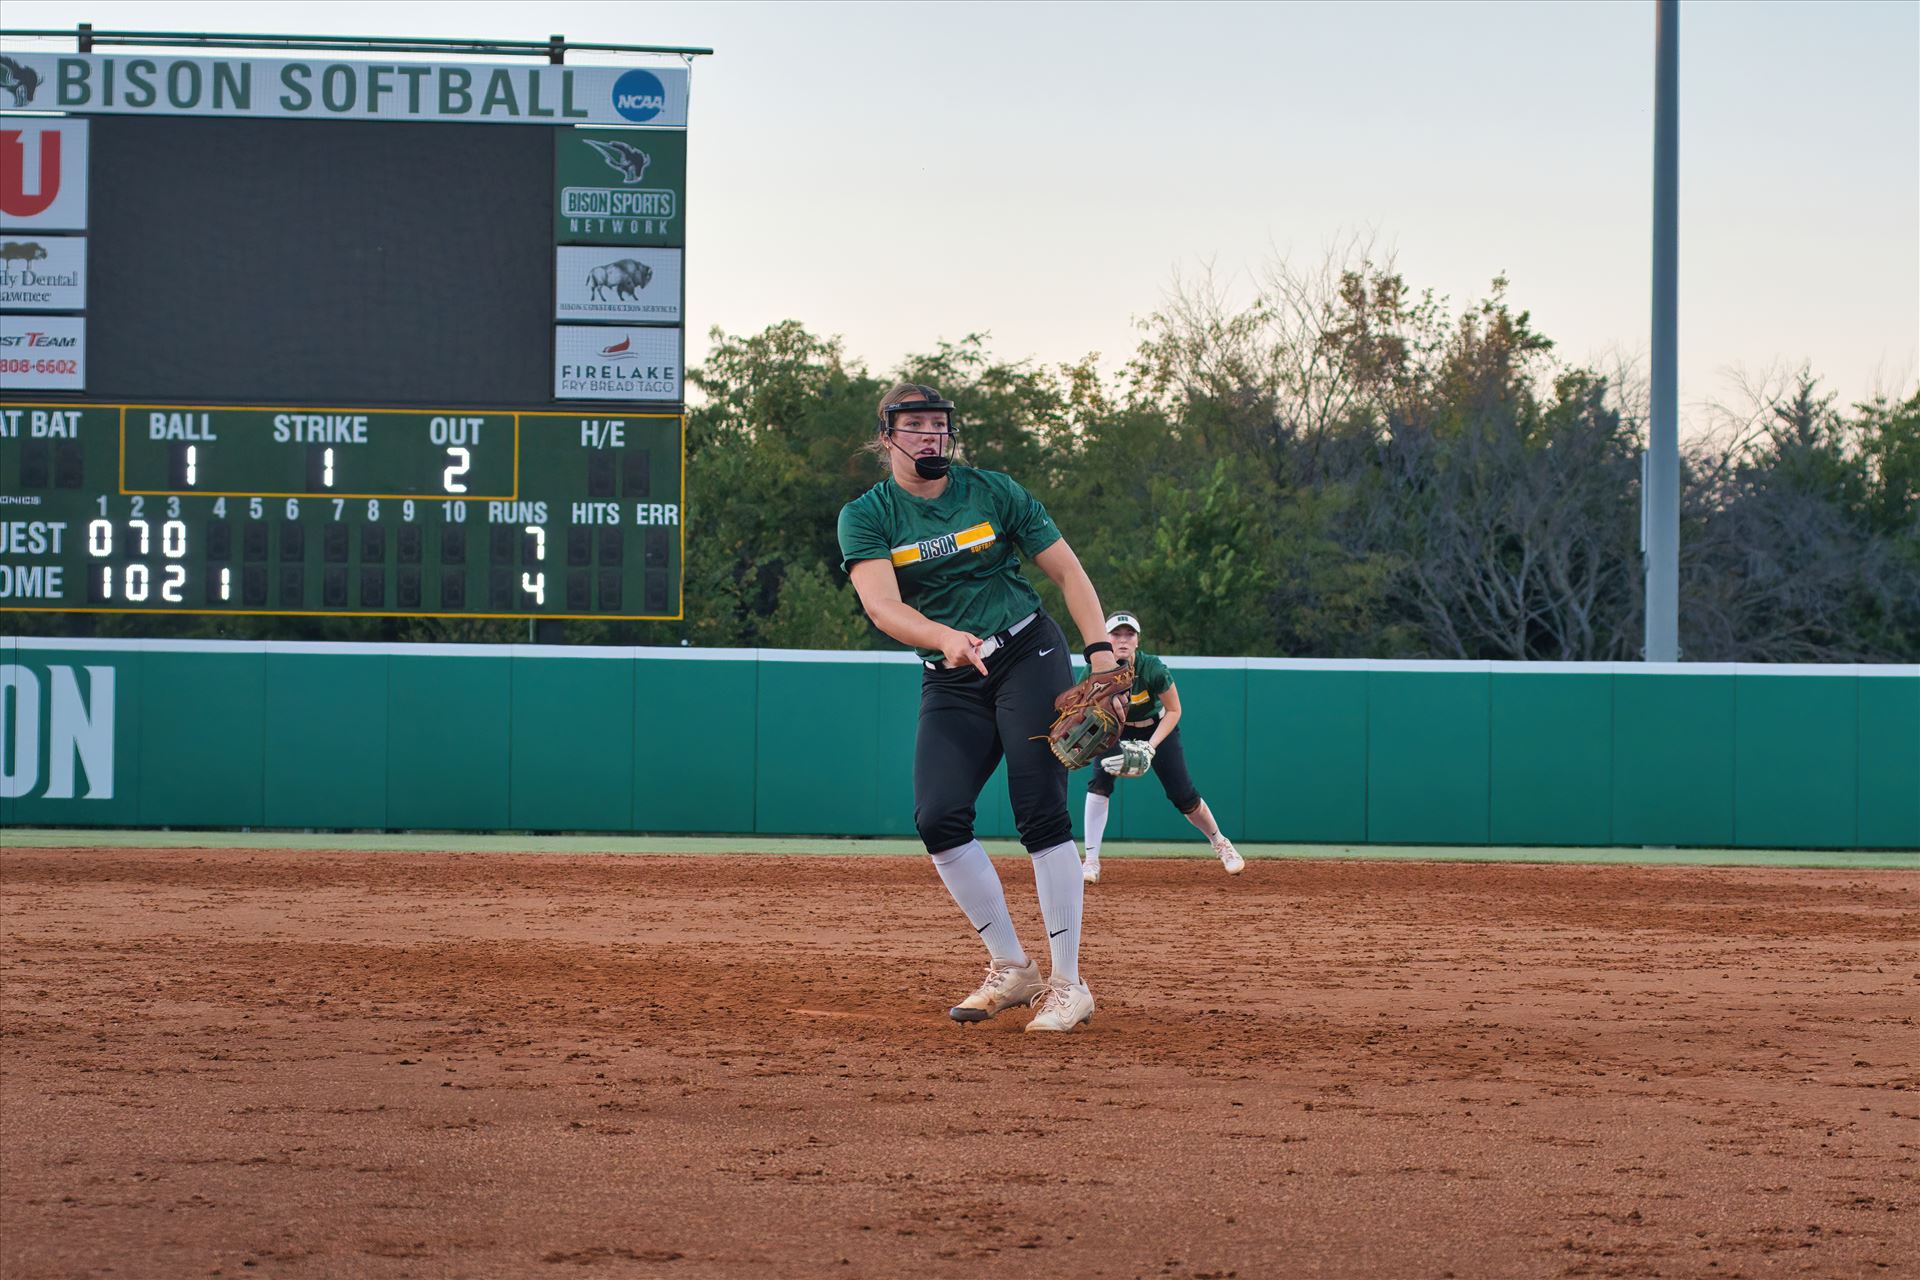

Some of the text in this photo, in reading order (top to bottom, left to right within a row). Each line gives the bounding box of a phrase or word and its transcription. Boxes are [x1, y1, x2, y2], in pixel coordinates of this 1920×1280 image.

[57, 58, 588, 118] BISON SOFTBALL
[618, 94, 662, 109] NCAA
[568, 191, 671, 215] BISON SPORTS
[570, 218, 667, 235] NETWORK
[0, 269, 78, 288] ly Dental
[0, 335, 24, 347] ST
[562, 365, 675, 380] FIRELAKE
[562, 380, 675, 393] FRY BREAD TACO
[31, 411, 83, 439] BAT
[149, 412, 217, 441] BALL
[273, 414, 368, 444] STRIKE
[430, 416, 484, 446] OUT
[581, 419, 625, 450] H/E
[187, 445, 196, 486] 1
[324, 447, 334, 487] 1
[444, 447, 470, 493] 2
[96, 494, 679, 526] 1 2 3 4 5 6 7 8 9 10 RUNS HITS ERR
[89, 519, 186, 558] 0 7 0
[525, 526, 545, 560] 7
[918, 534, 959, 561] BISON
[103, 564, 230, 602] 1 0 2 1
[522, 572, 545, 605] 4
